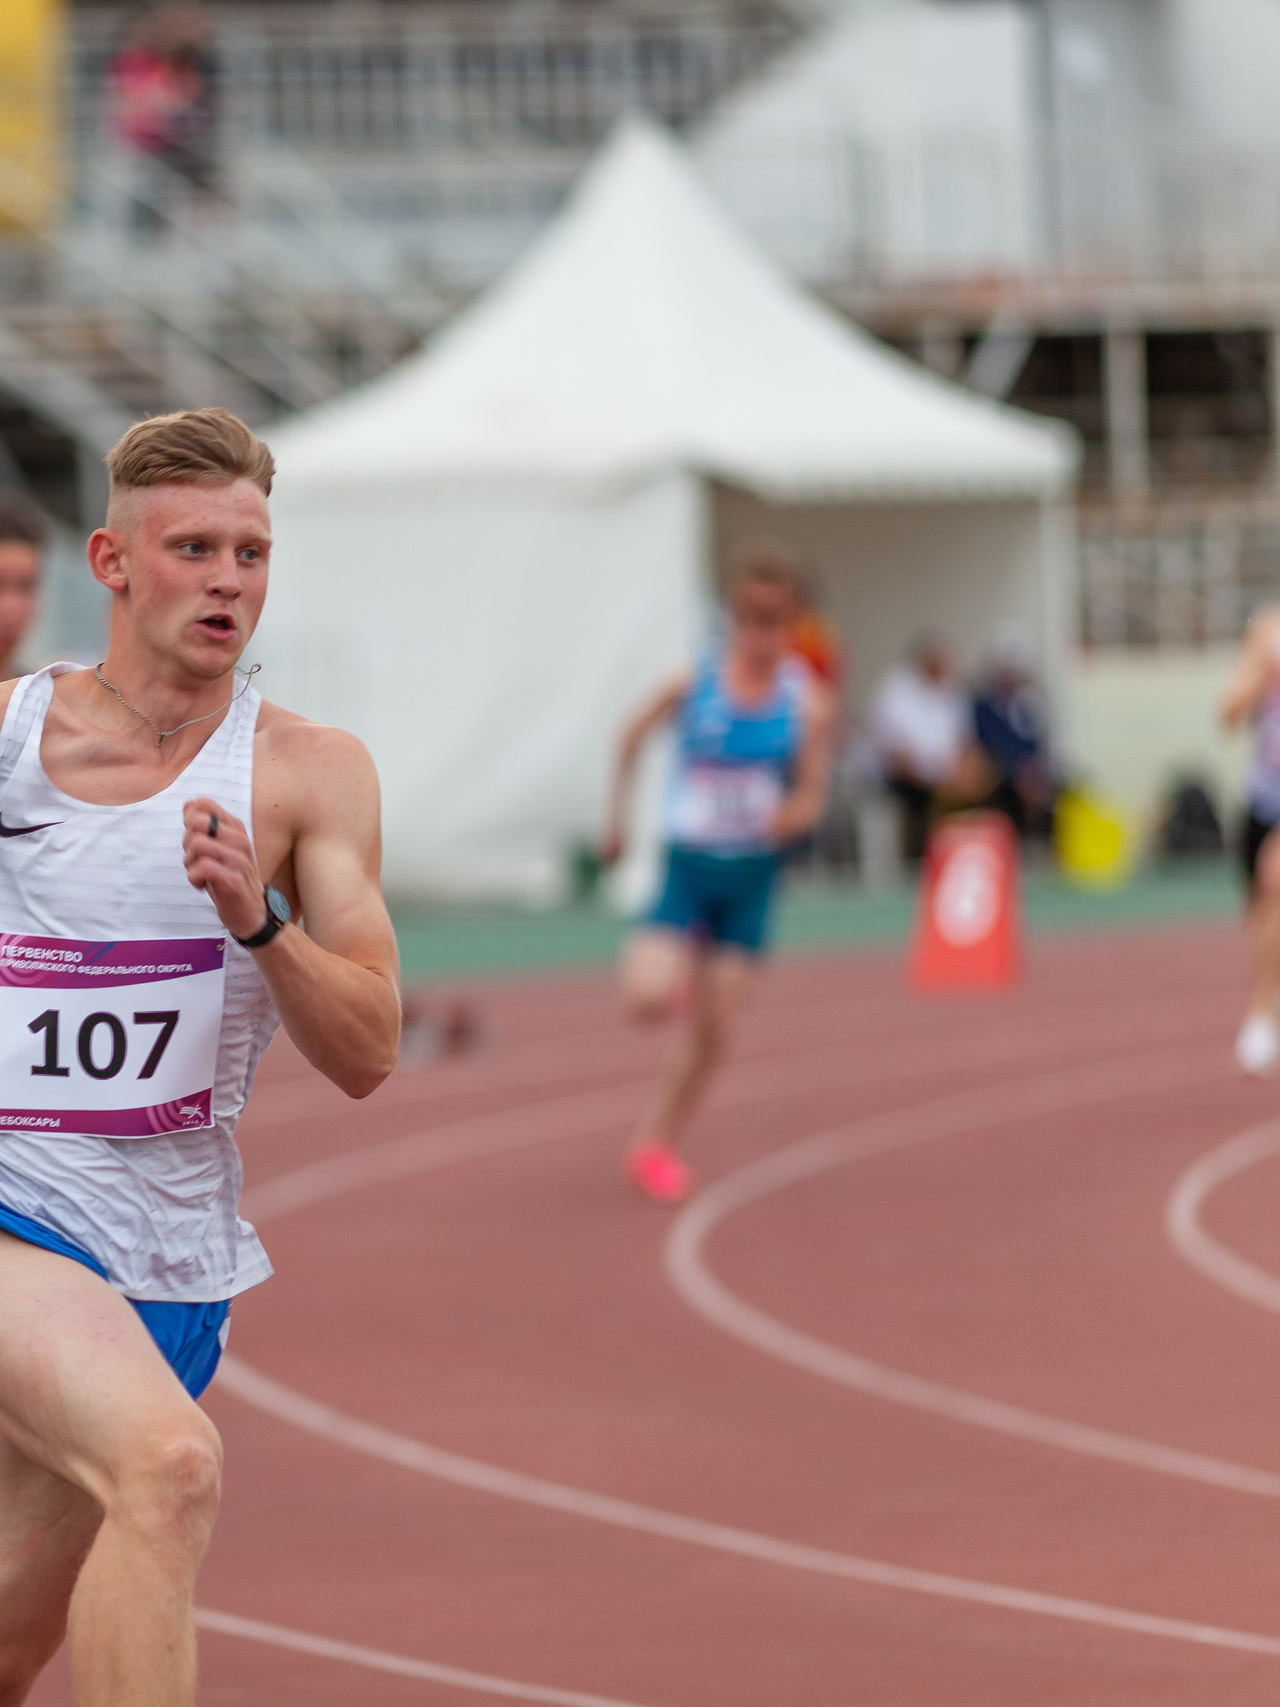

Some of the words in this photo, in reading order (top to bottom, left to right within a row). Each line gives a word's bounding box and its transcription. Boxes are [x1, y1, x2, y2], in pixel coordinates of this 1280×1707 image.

[1, 945, 83, 963] ПЕРВЕНСТВО
[0, 958, 76, 973] ПРИВОЛЖСКОГО
[77, 965, 156, 976] ФЕДЕРАЛЬНОГО
[156, 963, 193, 974] ОКРУГА
[27, 1009, 180, 1080] 107
